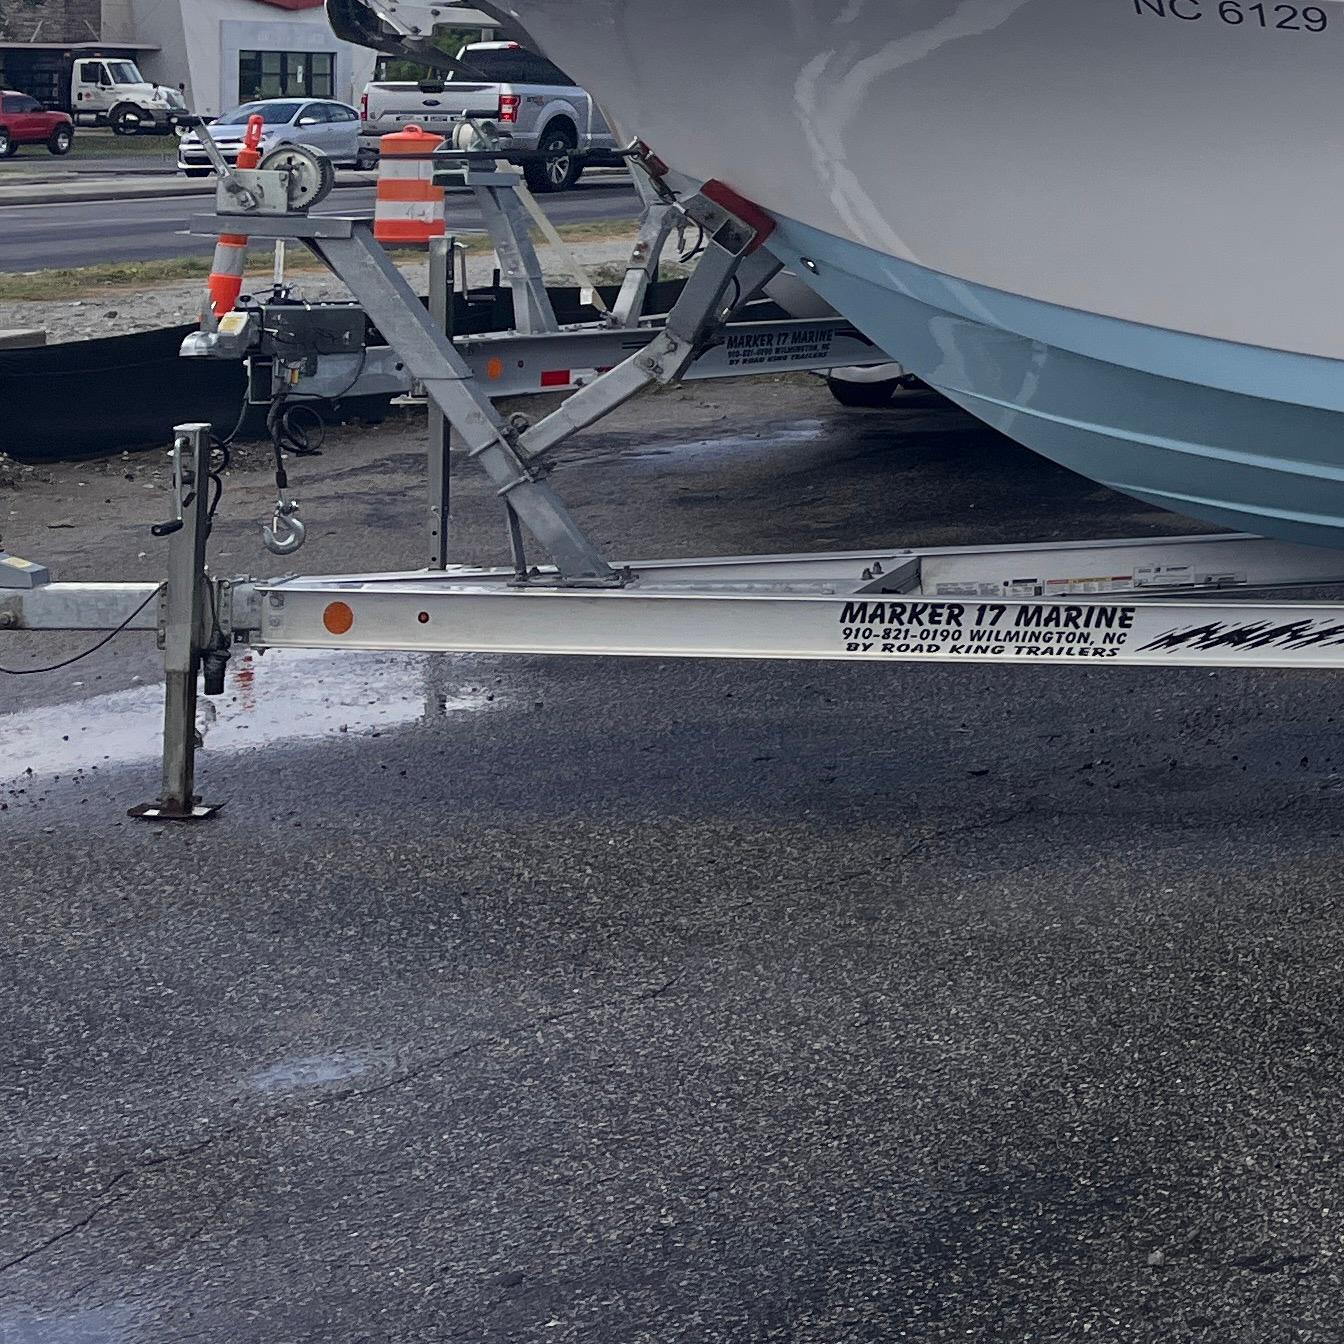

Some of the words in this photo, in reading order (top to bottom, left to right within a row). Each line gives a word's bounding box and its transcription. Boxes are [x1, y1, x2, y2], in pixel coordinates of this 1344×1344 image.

[1218, 0, 1328, 33] 6129
[839, 602, 965, 627] MARKER
[975, 605, 1007, 627] 17
[1014, 606, 1136, 629] MARINE
[842, 627, 963, 642] 910-821-0190
[969, 629, 1095, 645] WILMINGTON,
[1103, 632, 1127, 644] NC
[846, 642, 874, 653] BY
[881, 643, 941, 654] ROAD
[952, 644, 1006, 655] KING
[1014, 645, 1121, 657] TRAILERS
